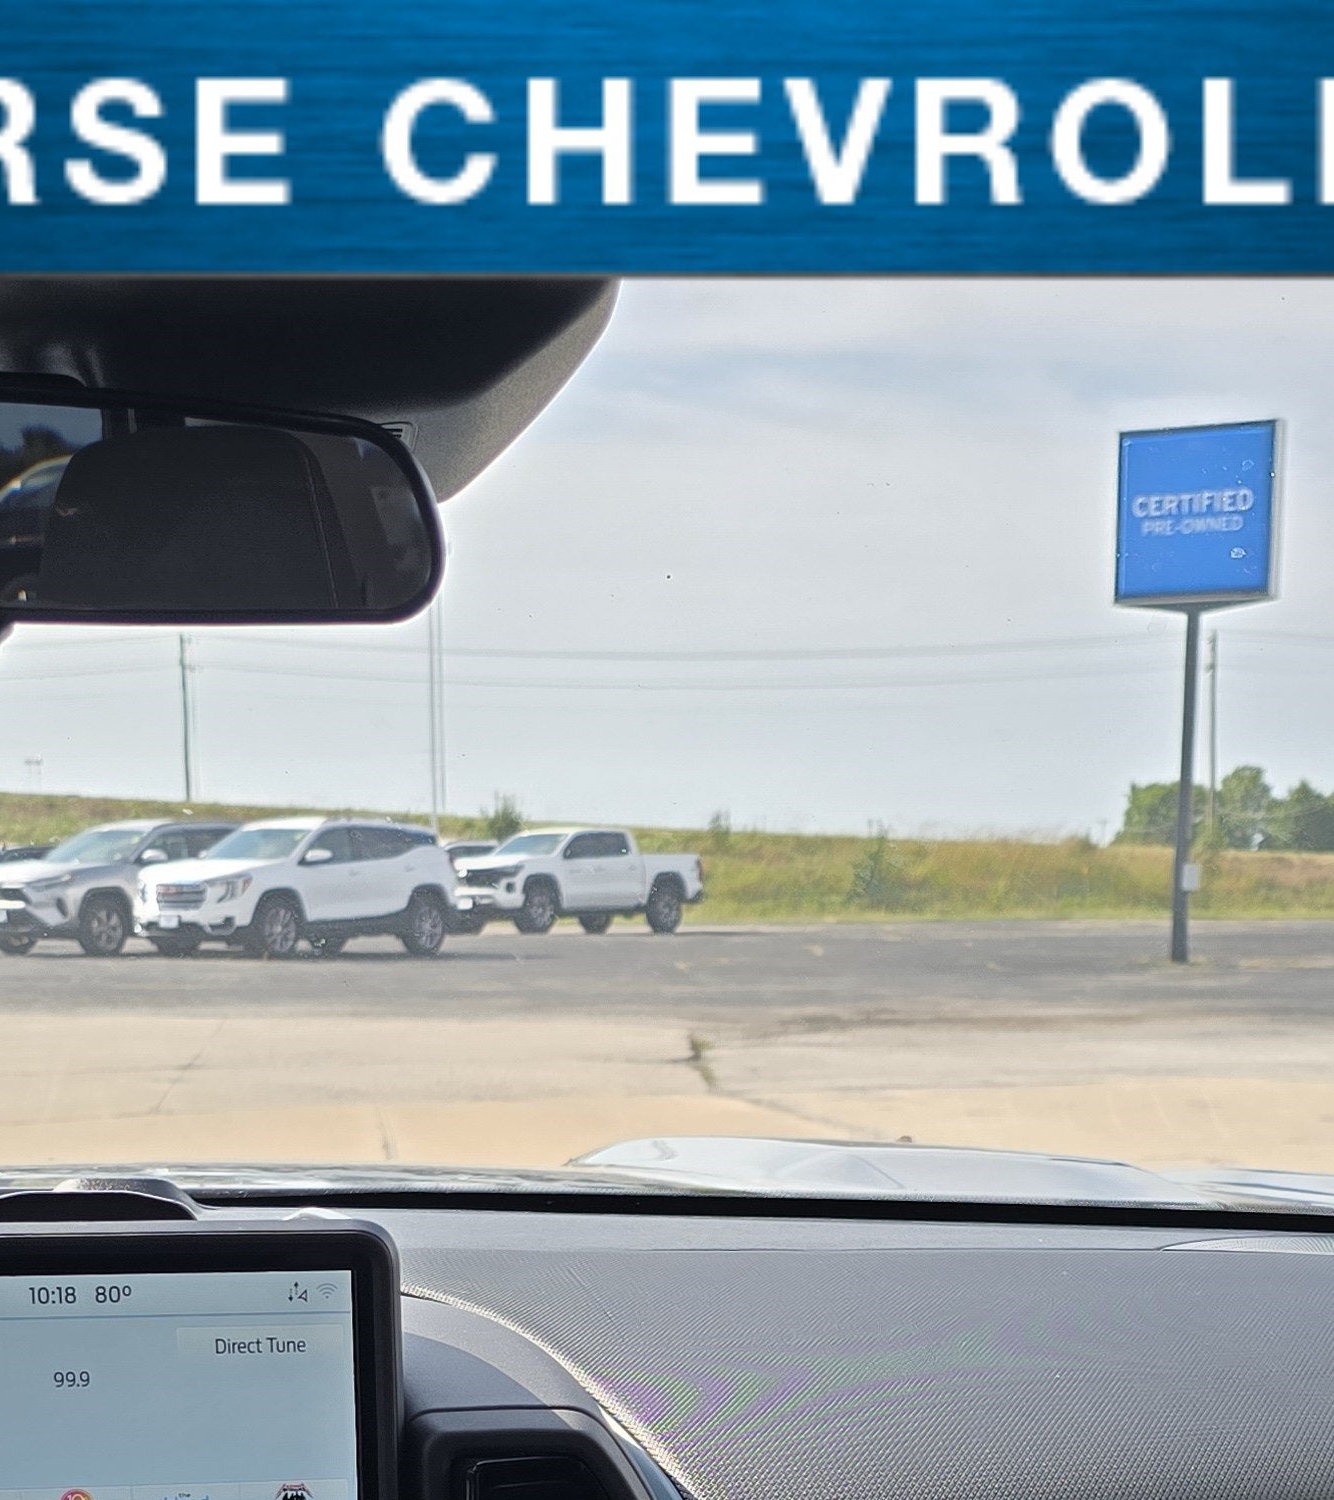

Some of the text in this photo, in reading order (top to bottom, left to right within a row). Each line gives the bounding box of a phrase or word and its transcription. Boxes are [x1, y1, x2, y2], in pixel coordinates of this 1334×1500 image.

[1132, 487, 1255, 517] CERTIFIED
[1141, 515, 1244, 536] PRE-OWNED
[28, 1286, 76, 1304] 10:18
[214, 1337, 307, 1354] Direct Tune
[53, 1371, 90, 1388] 99.9
